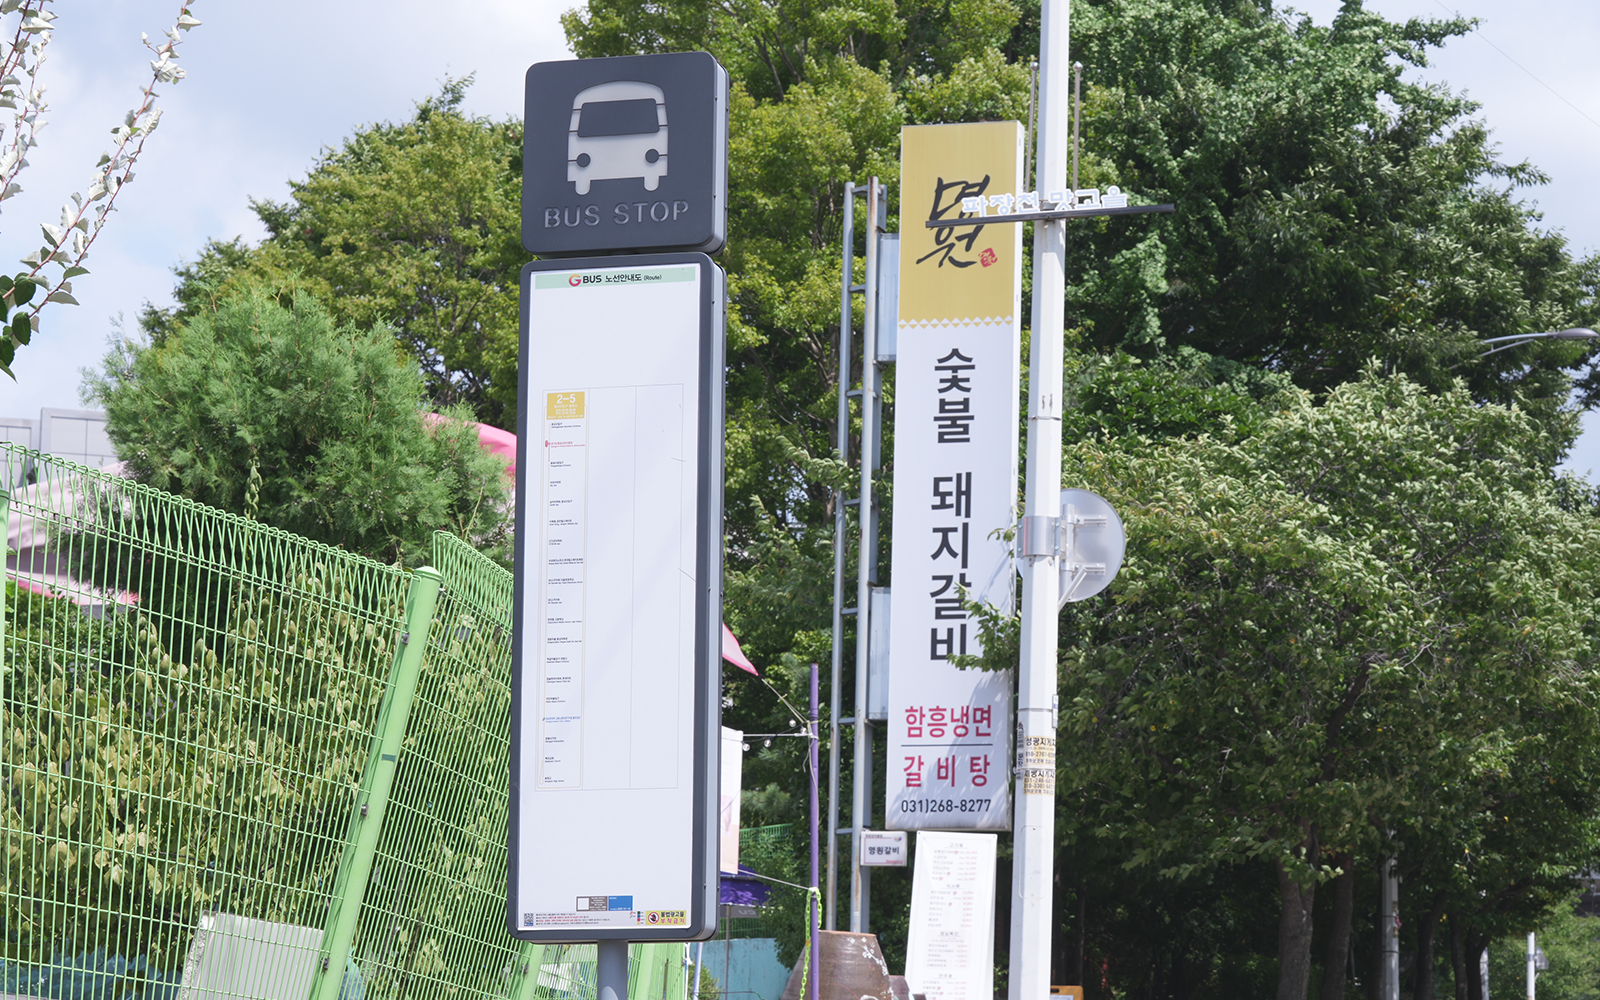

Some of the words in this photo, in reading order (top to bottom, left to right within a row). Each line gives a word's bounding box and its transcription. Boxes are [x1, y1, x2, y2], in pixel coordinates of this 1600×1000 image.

[1048, 185, 1128, 212] 맛고을
[544, 205, 601, 228] BUS
[613, 199, 690, 226] STOP
[605, 273, 642, 284] 노선안내도
[556, 393, 577, 404] 2-5
[933, 347, 976, 444] 숯불
[929, 471, 973, 672] 돼지갈비
[904, 704, 992, 739] 함흥냉면
[901, 798, 992, 814] 031)268-8277
